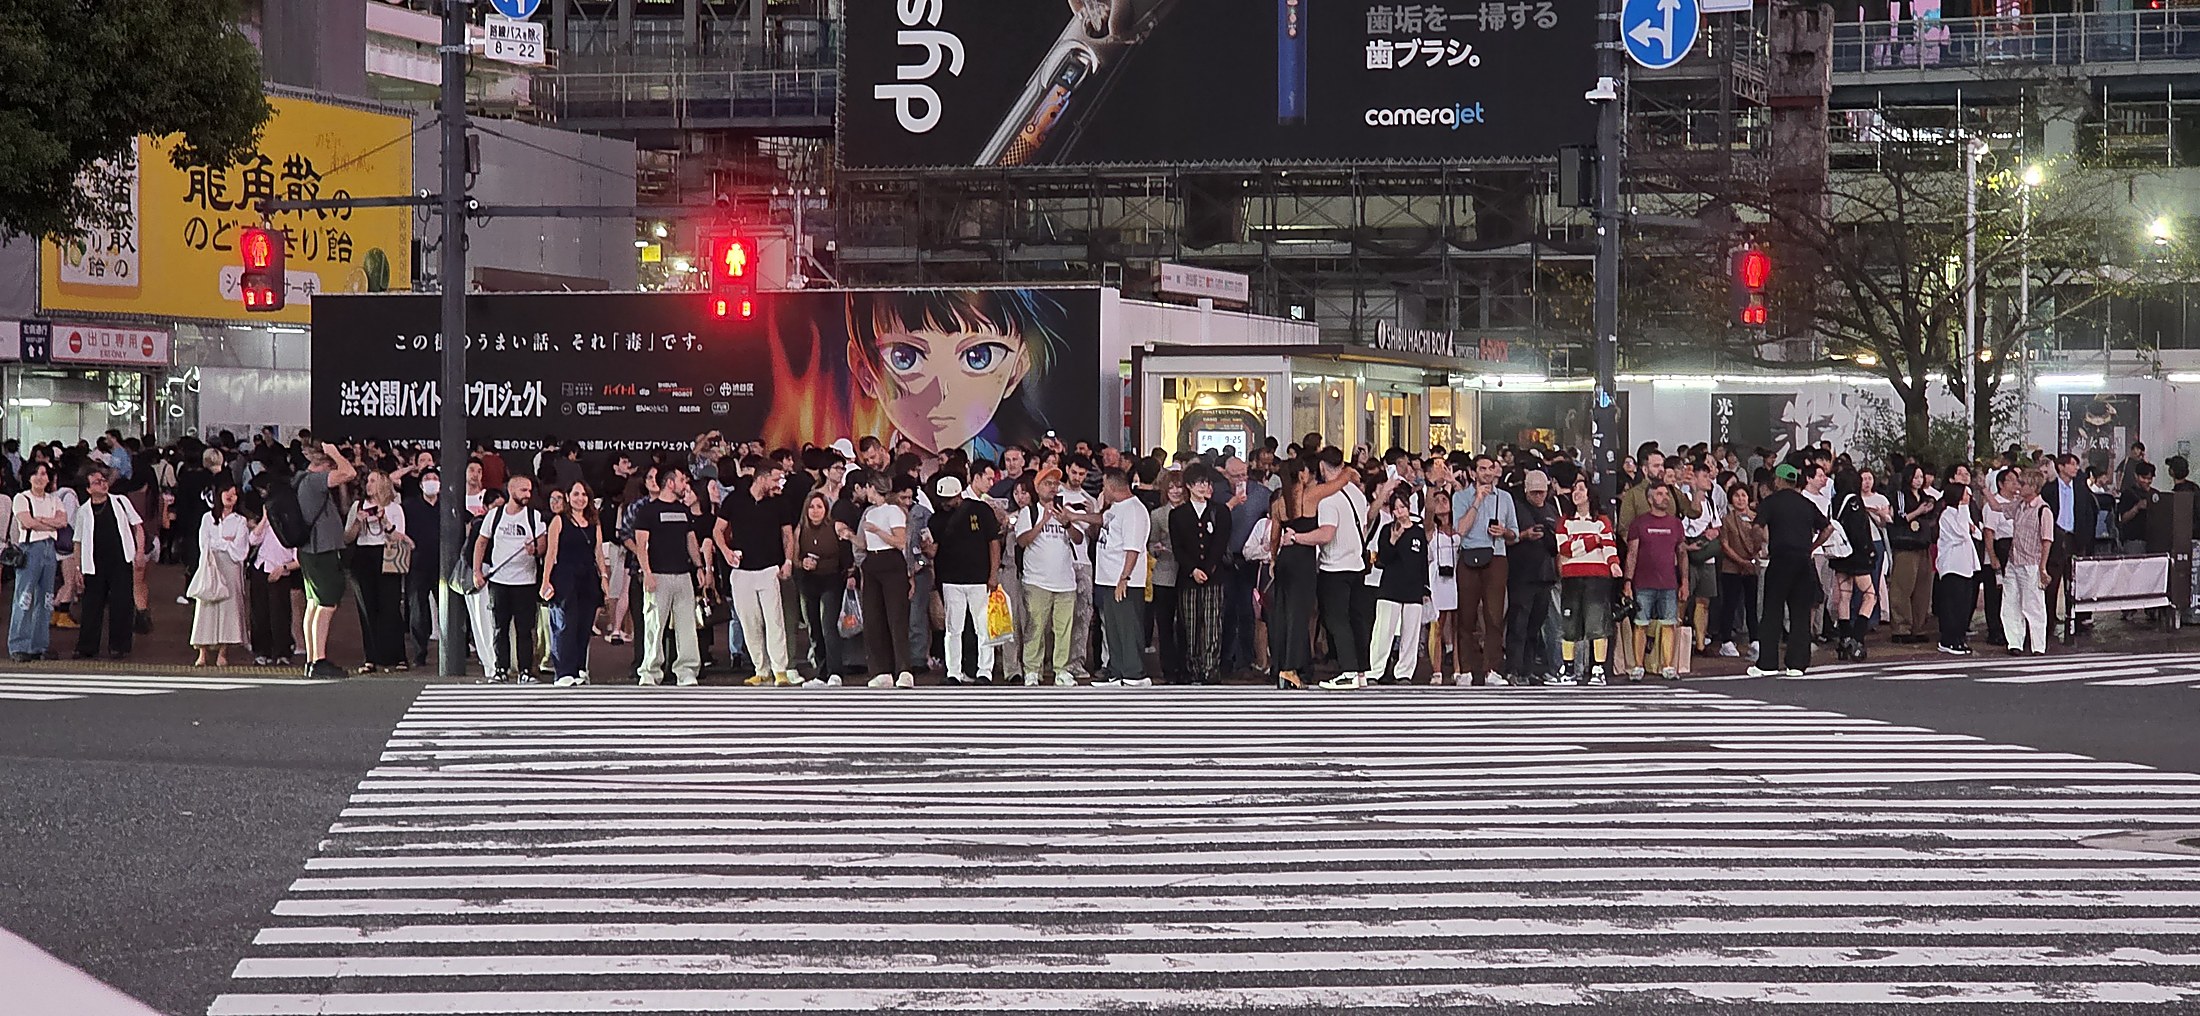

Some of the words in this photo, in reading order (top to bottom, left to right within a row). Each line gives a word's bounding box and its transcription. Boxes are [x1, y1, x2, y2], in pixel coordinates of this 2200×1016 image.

[490, 24, 540, 42] 路線バスを除く
[1366, 2, 1558, 35] 歯垢を一掃する
[1366, 38, 1481, 70] 歯ブラシ。
[1365, 102, 1484, 130] camerajet
[184, 215, 353, 264] のどきり飴
[87, 332, 138, 349] 出口専用
[395, 331, 704, 352] このうまい話、それ「毒」です。
[1386, 324, 1408, 352] SHIBU
[1408, 328, 1431, 354] HACHI
[1431, 331, 1447, 356] BOX
[340, 380, 548, 417] 渋谷闇バイトプロジェクト
